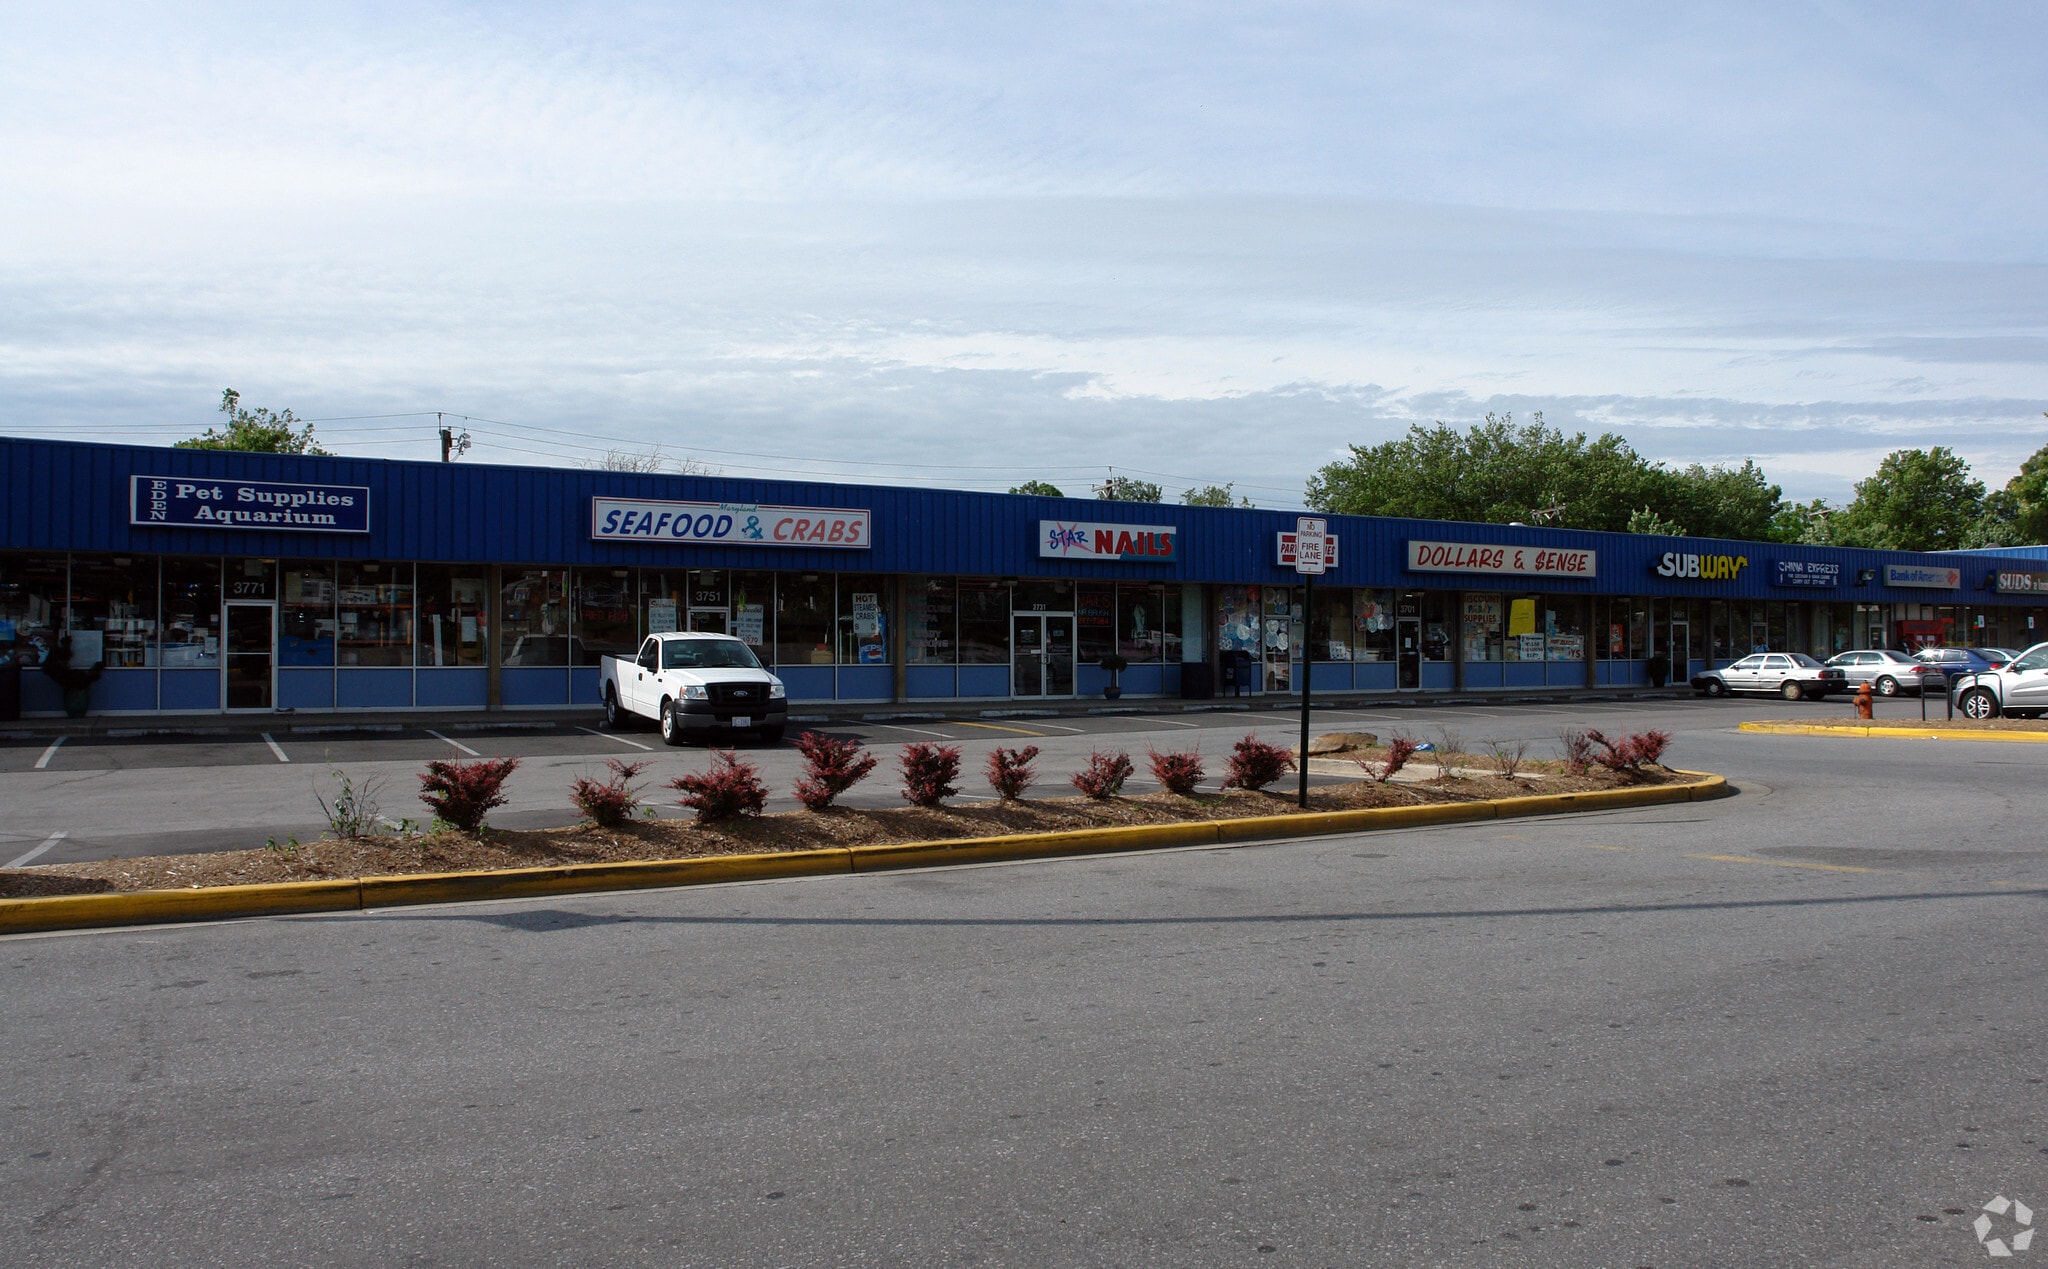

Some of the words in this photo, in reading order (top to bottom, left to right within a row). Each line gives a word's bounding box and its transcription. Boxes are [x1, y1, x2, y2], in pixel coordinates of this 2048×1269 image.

[150, 480, 167, 520] EDEN
[176, 483, 224, 501] Pet
[237, 487, 354, 507] Supplies
[718, 503, 758, 513] Maryland
[194, 505, 336, 525] Aquarium
[601, 509, 733, 538] SEAFOOD
[740, 515, 763, 540] &
[773, 517, 863, 543] CRABS
[1306, 523, 1315, 531] NO
[1300, 531, 1322, 539] PARKING
[1049, 529, 1089, 550] STAR
[1095, 529, 1173, 557] NAILS
[1301, 542, 1319, 551] FIRE
[1299, 551, 1322, 561] LANE
[1417, 545, 1504, 569] DOLLARS
[1513, 550, 1525, 570] &
[1535, 550, 1589, 572] $ENSE
[1657, 551, 1748, 580] SUBWAY
[1778, 561, 1804, 572] CHINA
[1808, 562, 1839, 574] EXPRESS
[1890, 568, 1910, 581] Bank
[1911, 569, 1919, 581] of
[233, 580, 265, 594] 3771
[1999, 573, 2032, 590] SUDS
[695, 590, 721, 602] 3751
[855, 594, 875, 602] HOT
[854, 603, 877, 611] STEAMED
[1400, 604, 1415, 614] 3701
[855, 612, 875, 621] CRABS
[1463, 614, 1497, 623] SUPPLIES
